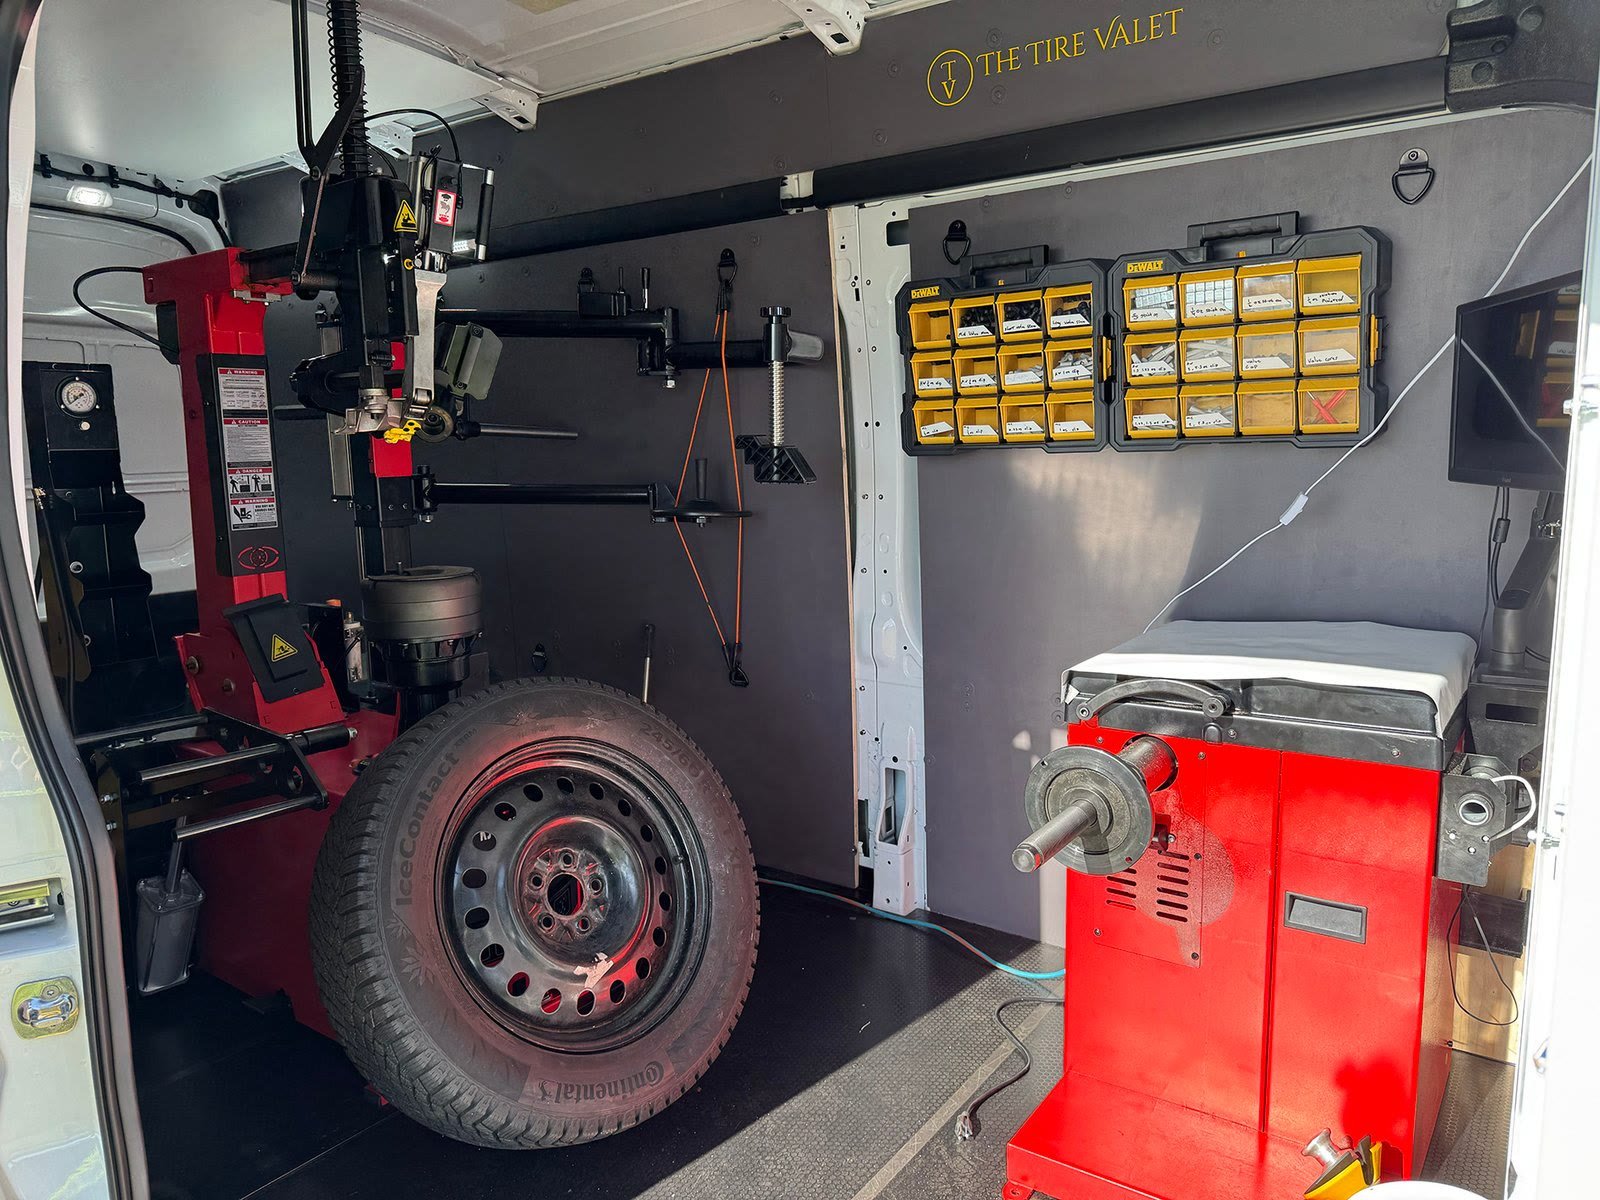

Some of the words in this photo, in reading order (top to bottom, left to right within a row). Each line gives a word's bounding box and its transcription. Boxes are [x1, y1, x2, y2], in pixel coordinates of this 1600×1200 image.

[975, 46, 1022, 77] THE
[1025, 31, 1087, 66] TIRE
[1093, 8, 1185, 51] VALET
[940, 60, 957, 81] T
[941, 79, 957, 100] V
[556, 1060, 665, 1105] Continental
